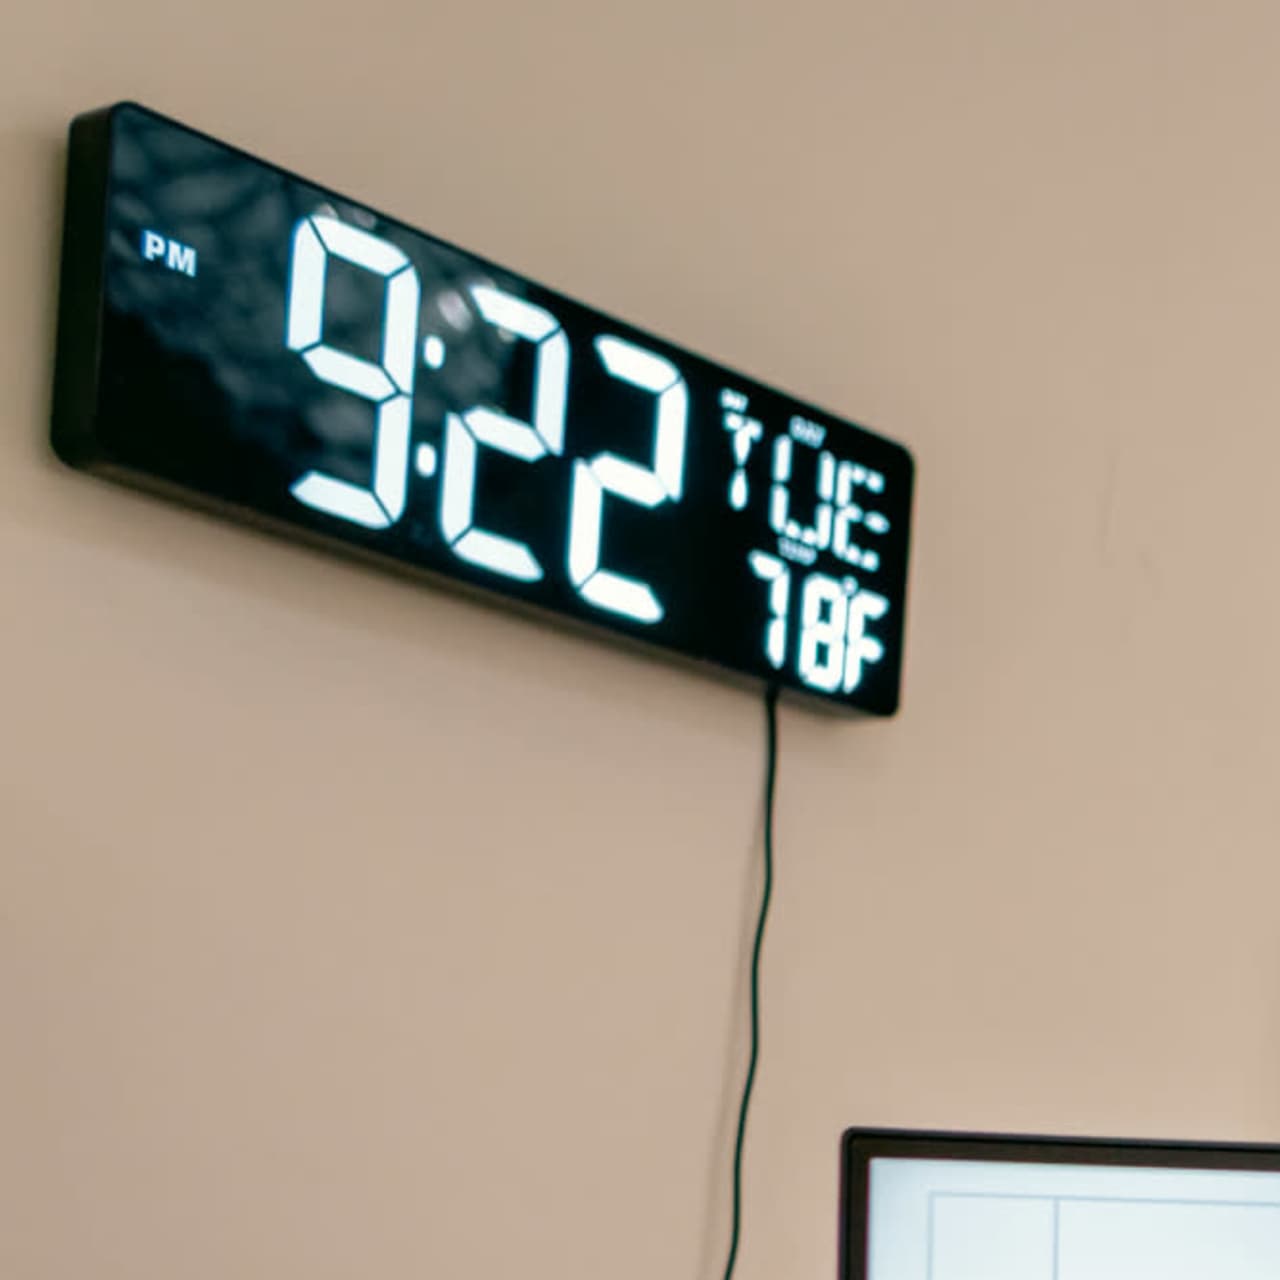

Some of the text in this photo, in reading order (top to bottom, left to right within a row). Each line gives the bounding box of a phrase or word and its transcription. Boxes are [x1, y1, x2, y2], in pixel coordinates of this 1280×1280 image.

[145, 231, 196, 276] PM
[287, 213, 688, 623] 9:22
[724, 412, 890, 572] TUE
